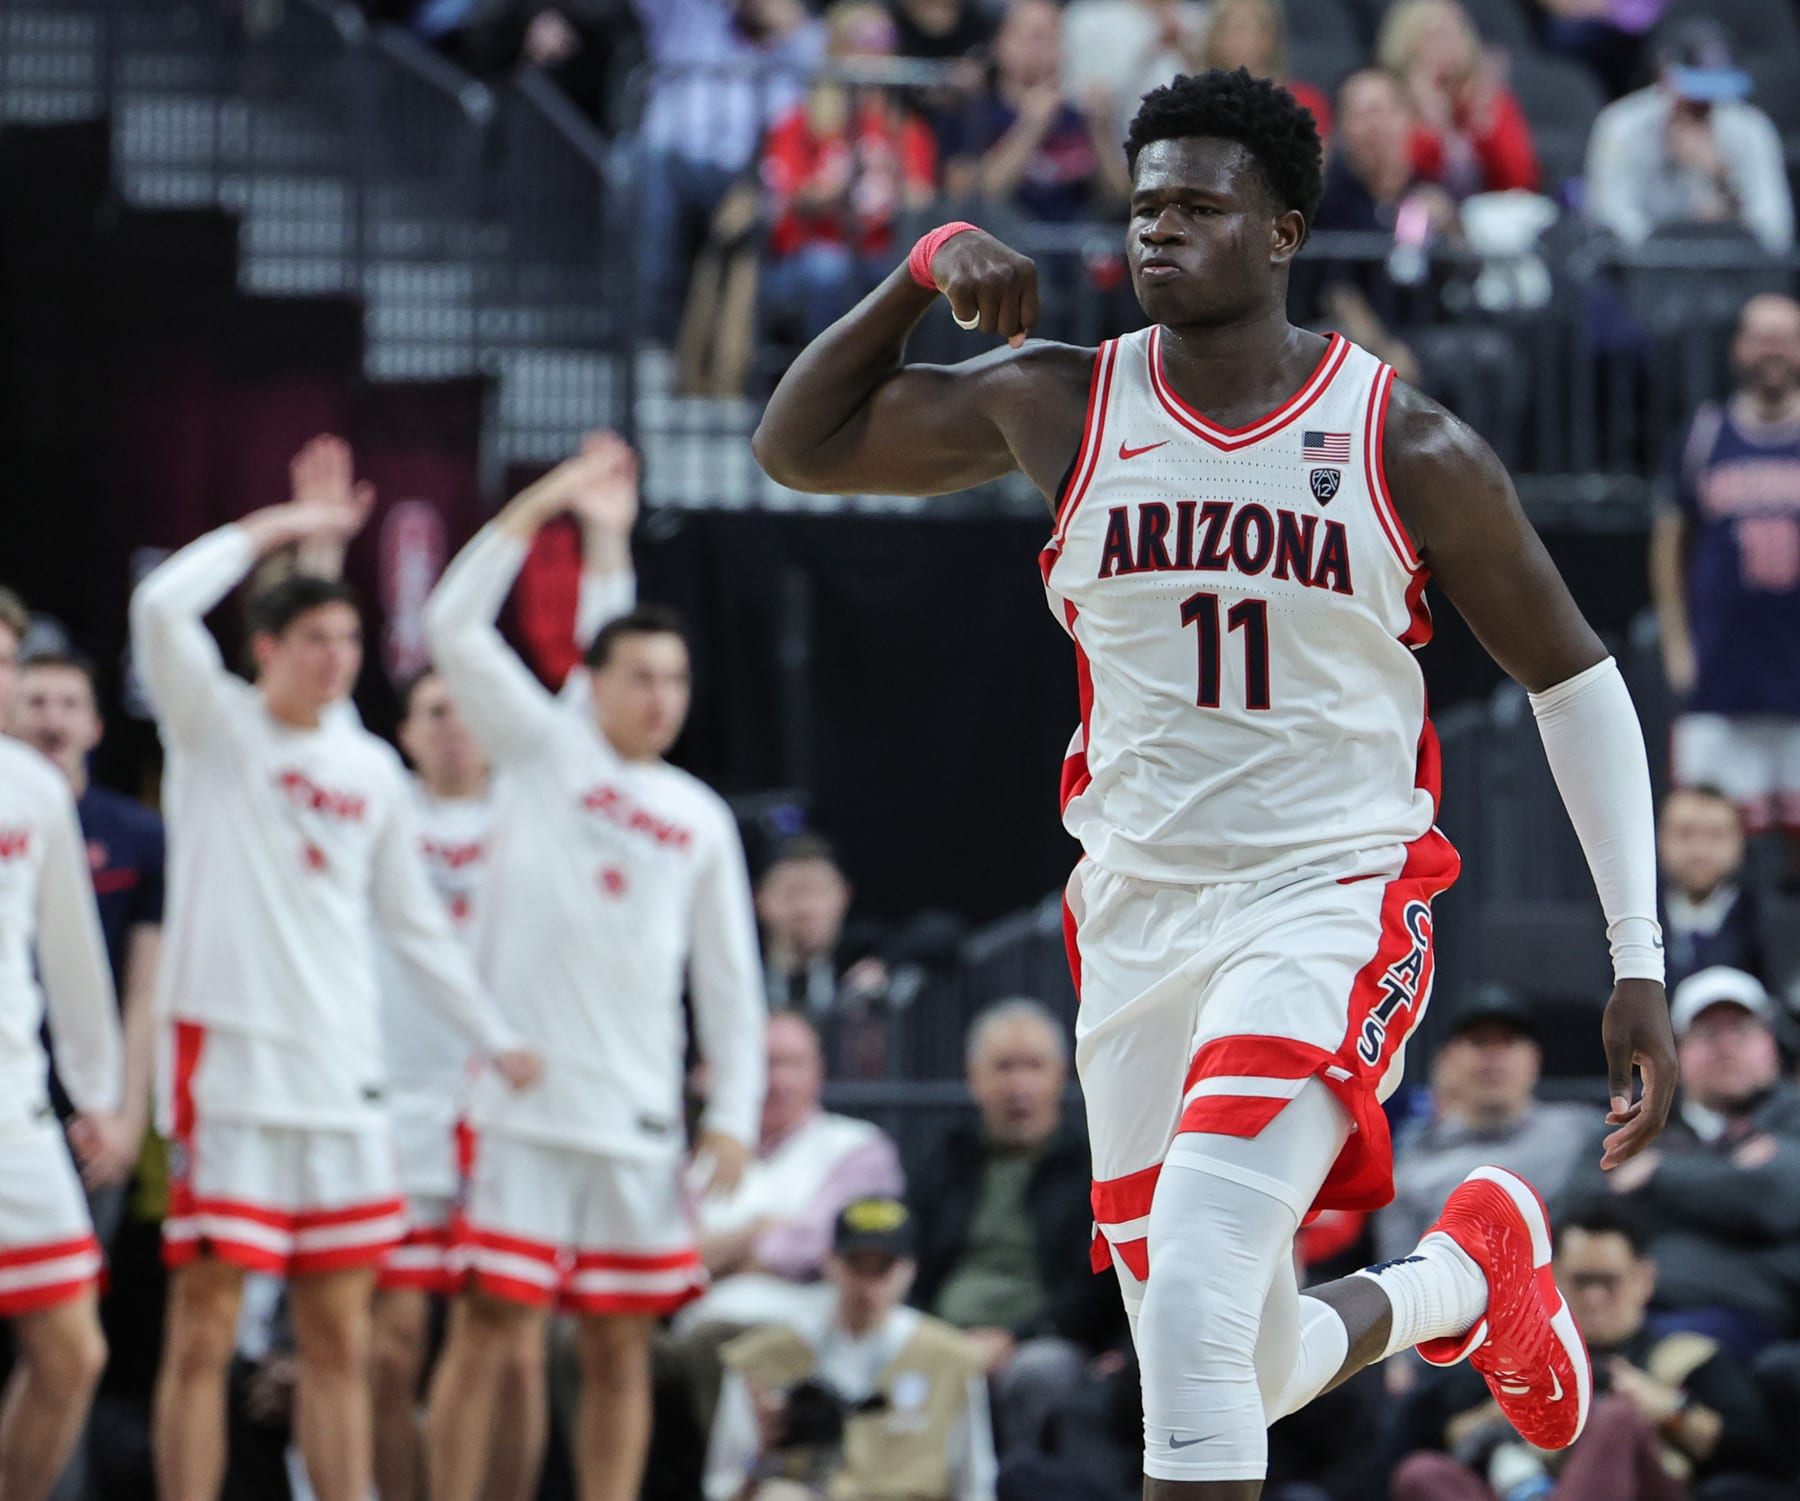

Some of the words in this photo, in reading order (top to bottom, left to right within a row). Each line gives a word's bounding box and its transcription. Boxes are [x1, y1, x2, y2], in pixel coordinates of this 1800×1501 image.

[1312, 470, 1339, 490] PAC
[1317, 483, 1331, 497] 12
[1098, 501, 1353, 595] ARIZONA
[1180, 592, 1271, 710] 11
[1356, 900, 1431, 1067] CATS
